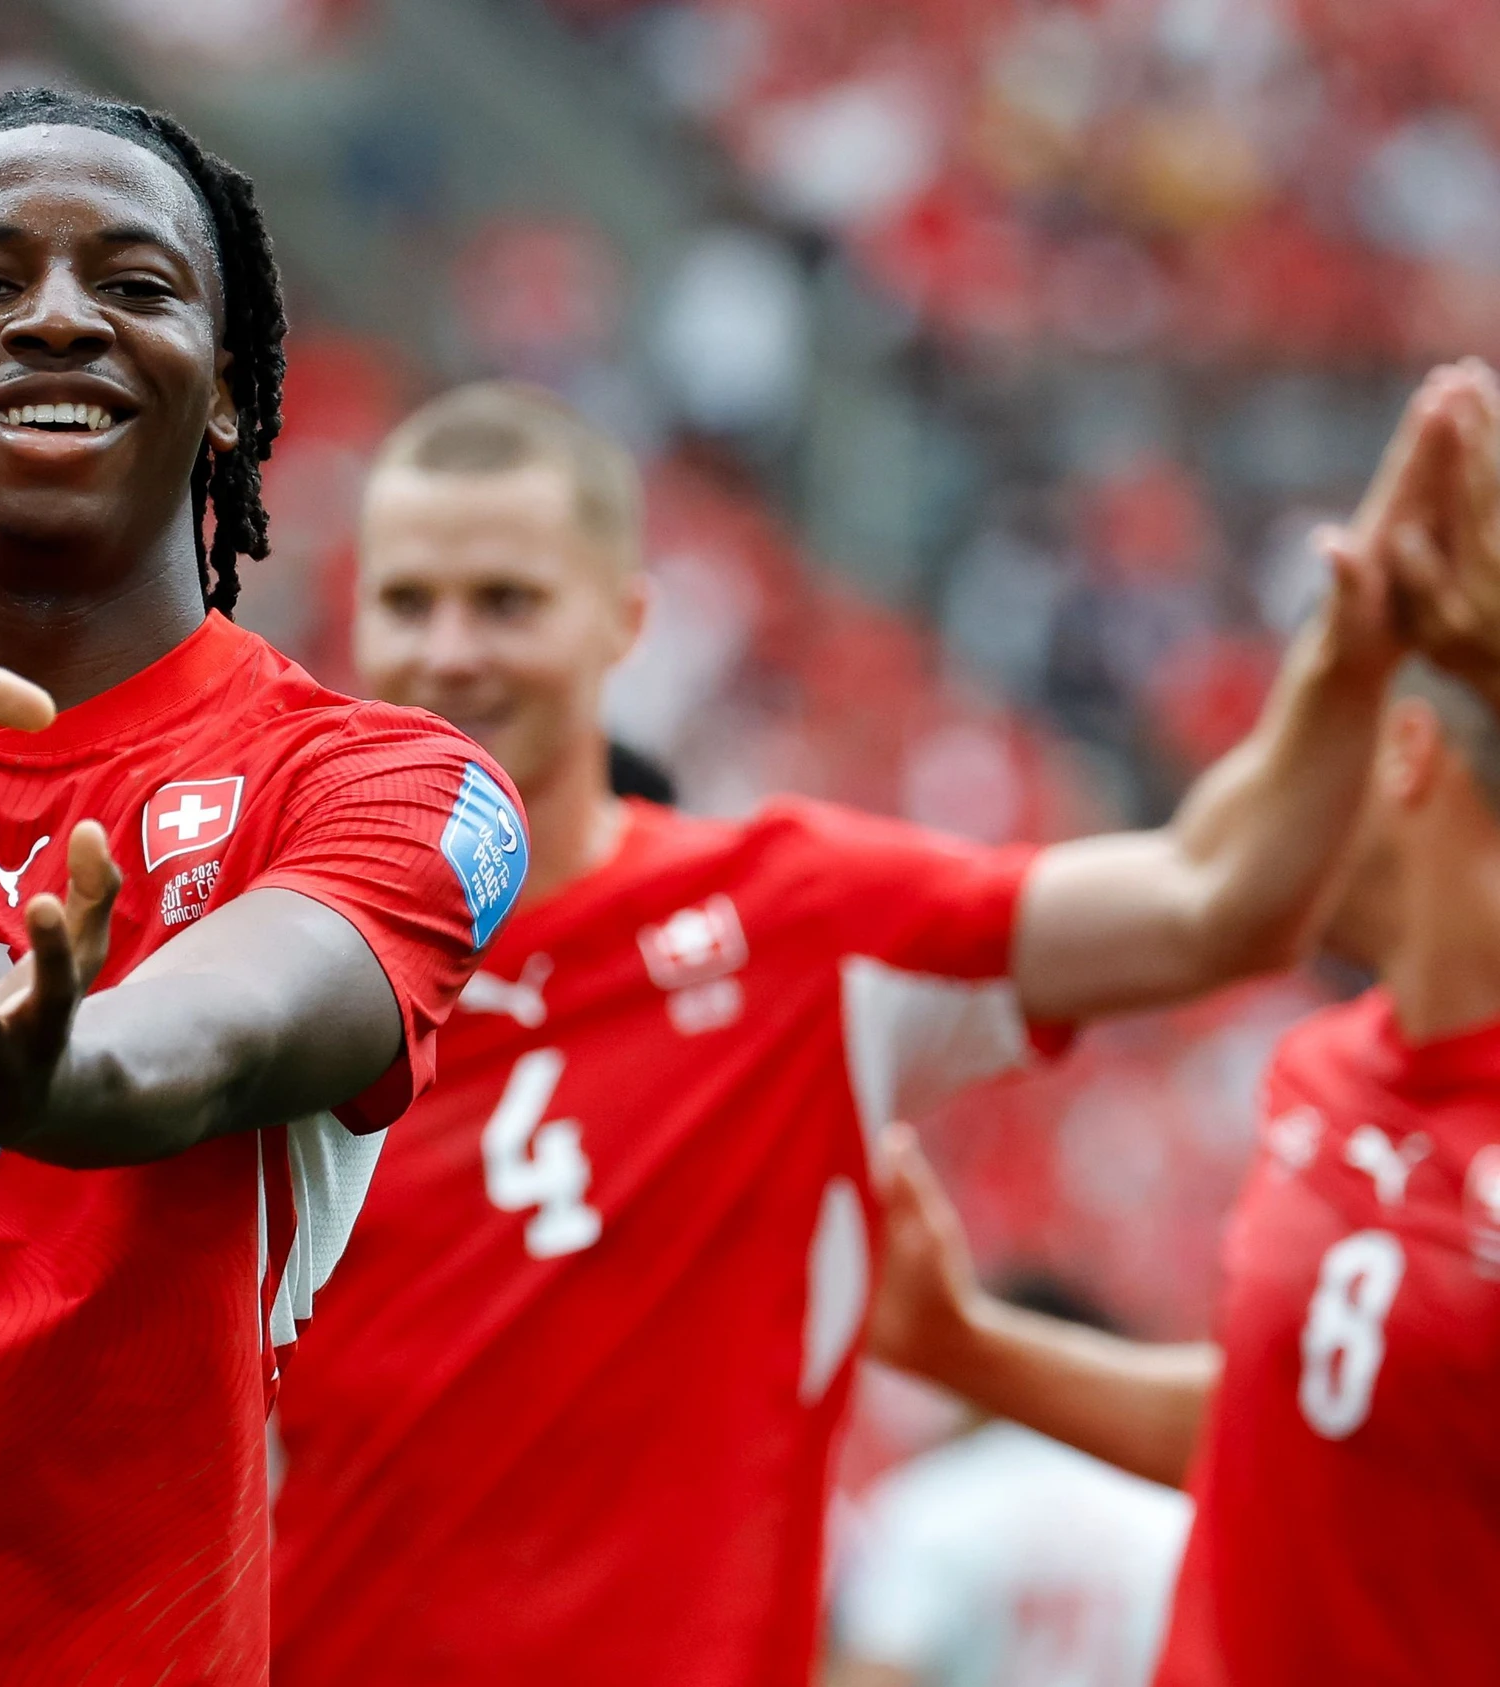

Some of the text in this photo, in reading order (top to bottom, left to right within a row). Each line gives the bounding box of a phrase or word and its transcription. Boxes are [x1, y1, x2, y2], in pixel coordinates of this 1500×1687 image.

[161, 888, 181, 914] SUI
[196, 877, 215, 900] CA
[471, 872, 487, 909] FIFA
[473, 841, 501, 909] PEACE
[164, 902, 207, 926] VANCOU
[481, 1046, 601, 1260] 4
[1297, 1229, 1406, 1441] 8
